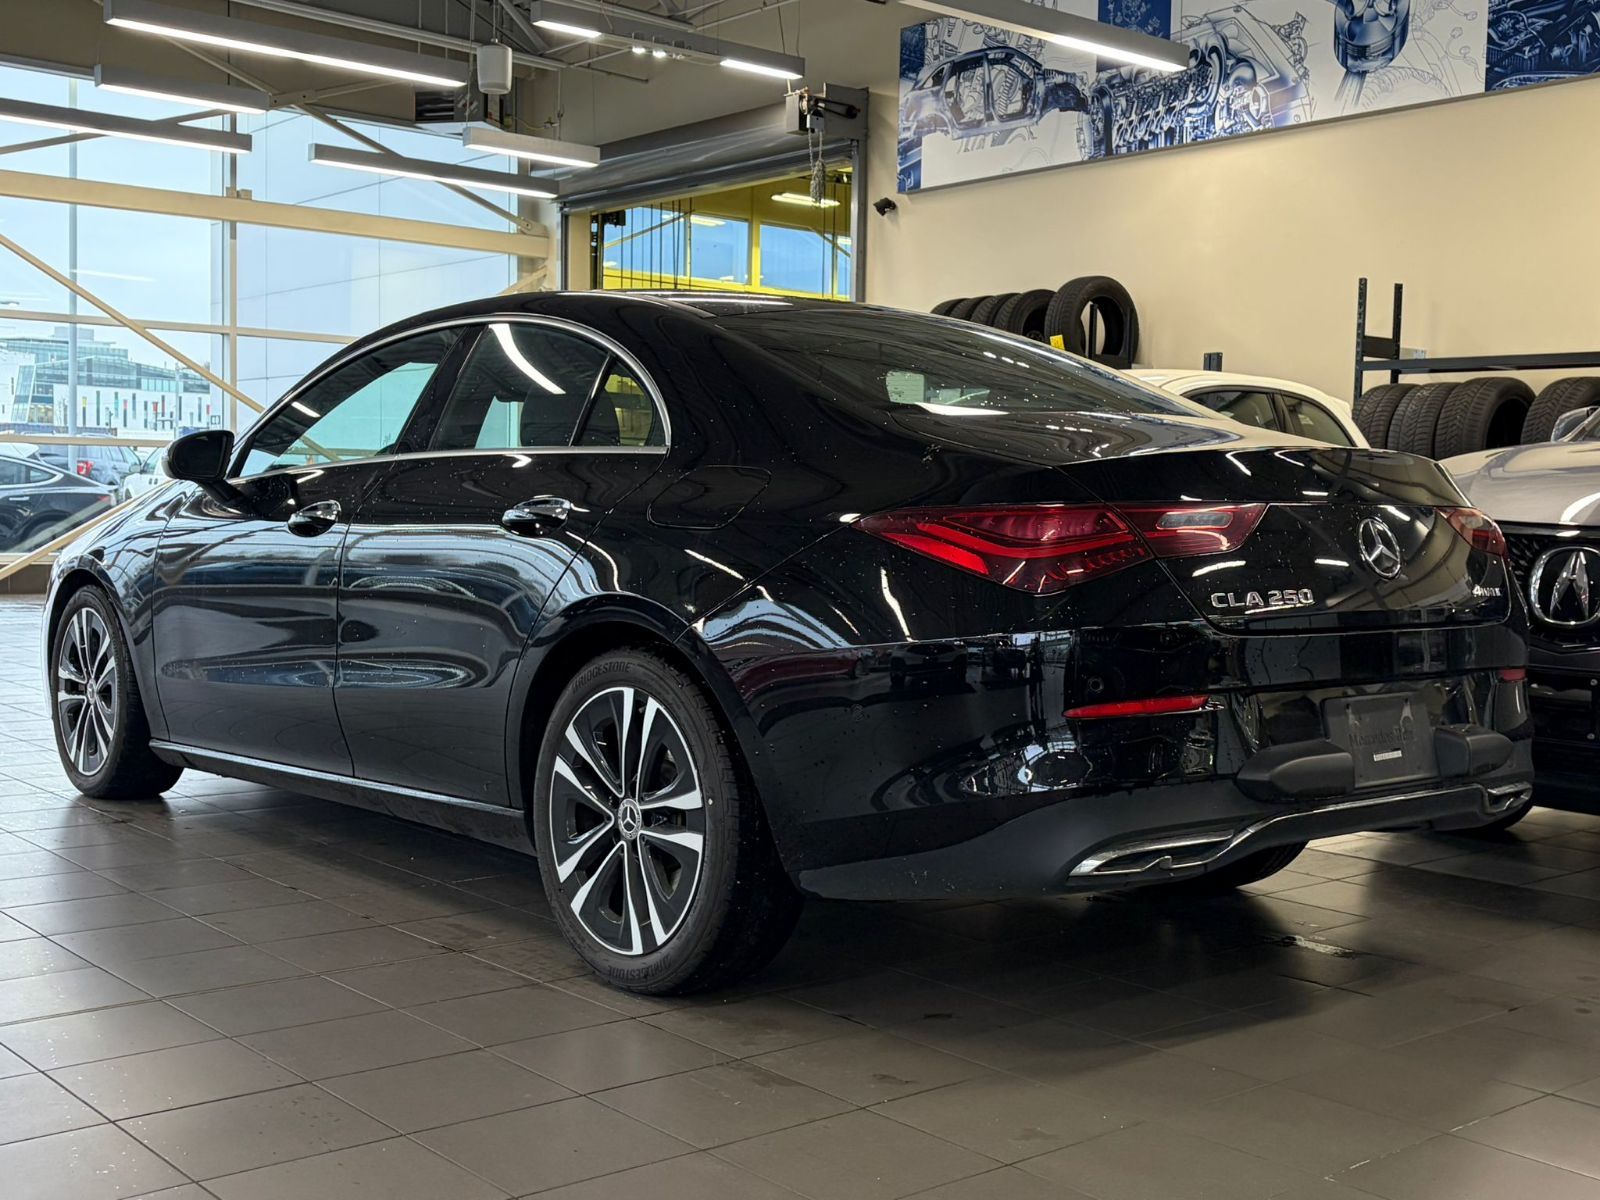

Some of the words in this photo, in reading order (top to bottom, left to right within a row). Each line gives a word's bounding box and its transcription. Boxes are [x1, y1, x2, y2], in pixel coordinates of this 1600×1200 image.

[1210, 591, 1264, 608] CLA
[1267, 588, 1315, 606] 250
[572, 661, 632, 694] BRIDGESTONE
